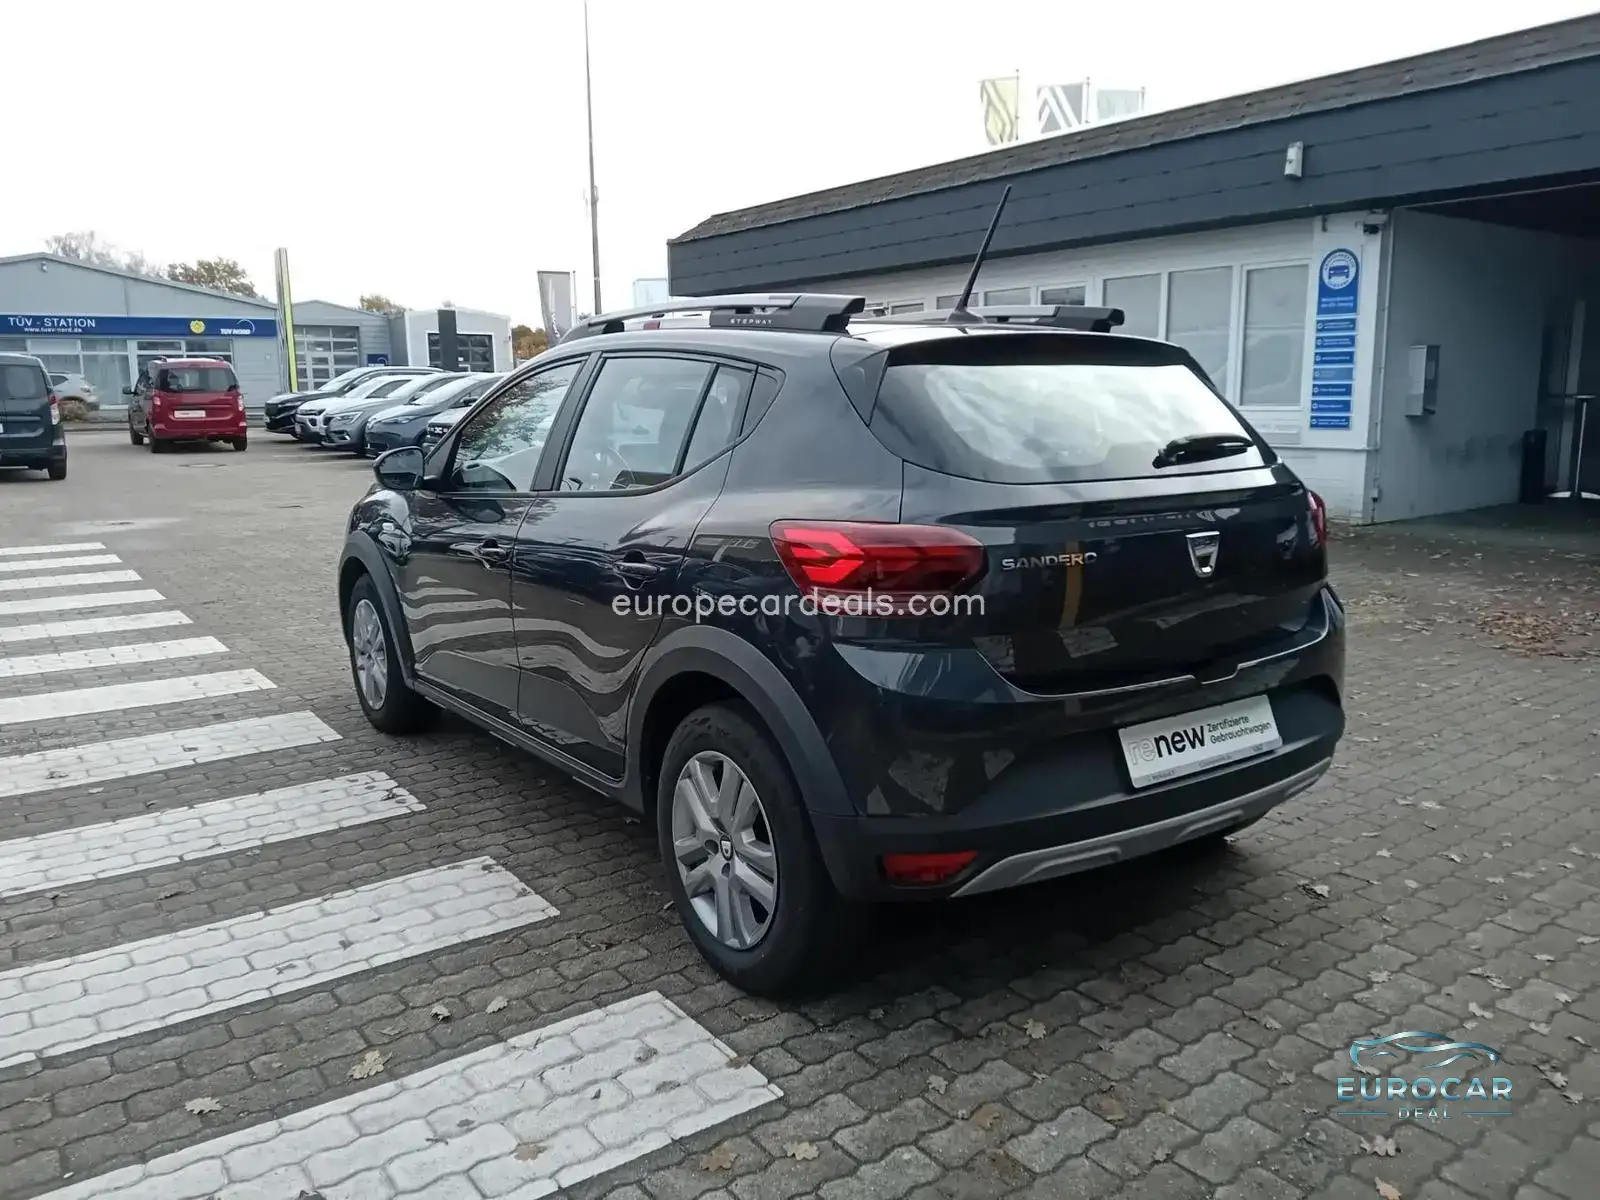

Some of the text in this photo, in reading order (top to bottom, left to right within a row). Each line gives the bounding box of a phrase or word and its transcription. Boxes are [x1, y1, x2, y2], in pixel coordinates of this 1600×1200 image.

[7, 315, 32, 327] TÜV
[43, 317, 96, 328] STATION
[1001, 551, 1098, 571] SANDERO
[1206, 714, 1250, 733] Zertifizierte
[1209, 721, 1273, 745] Gebrauchtwagen
[1127, 725, 1206, 766] renew
